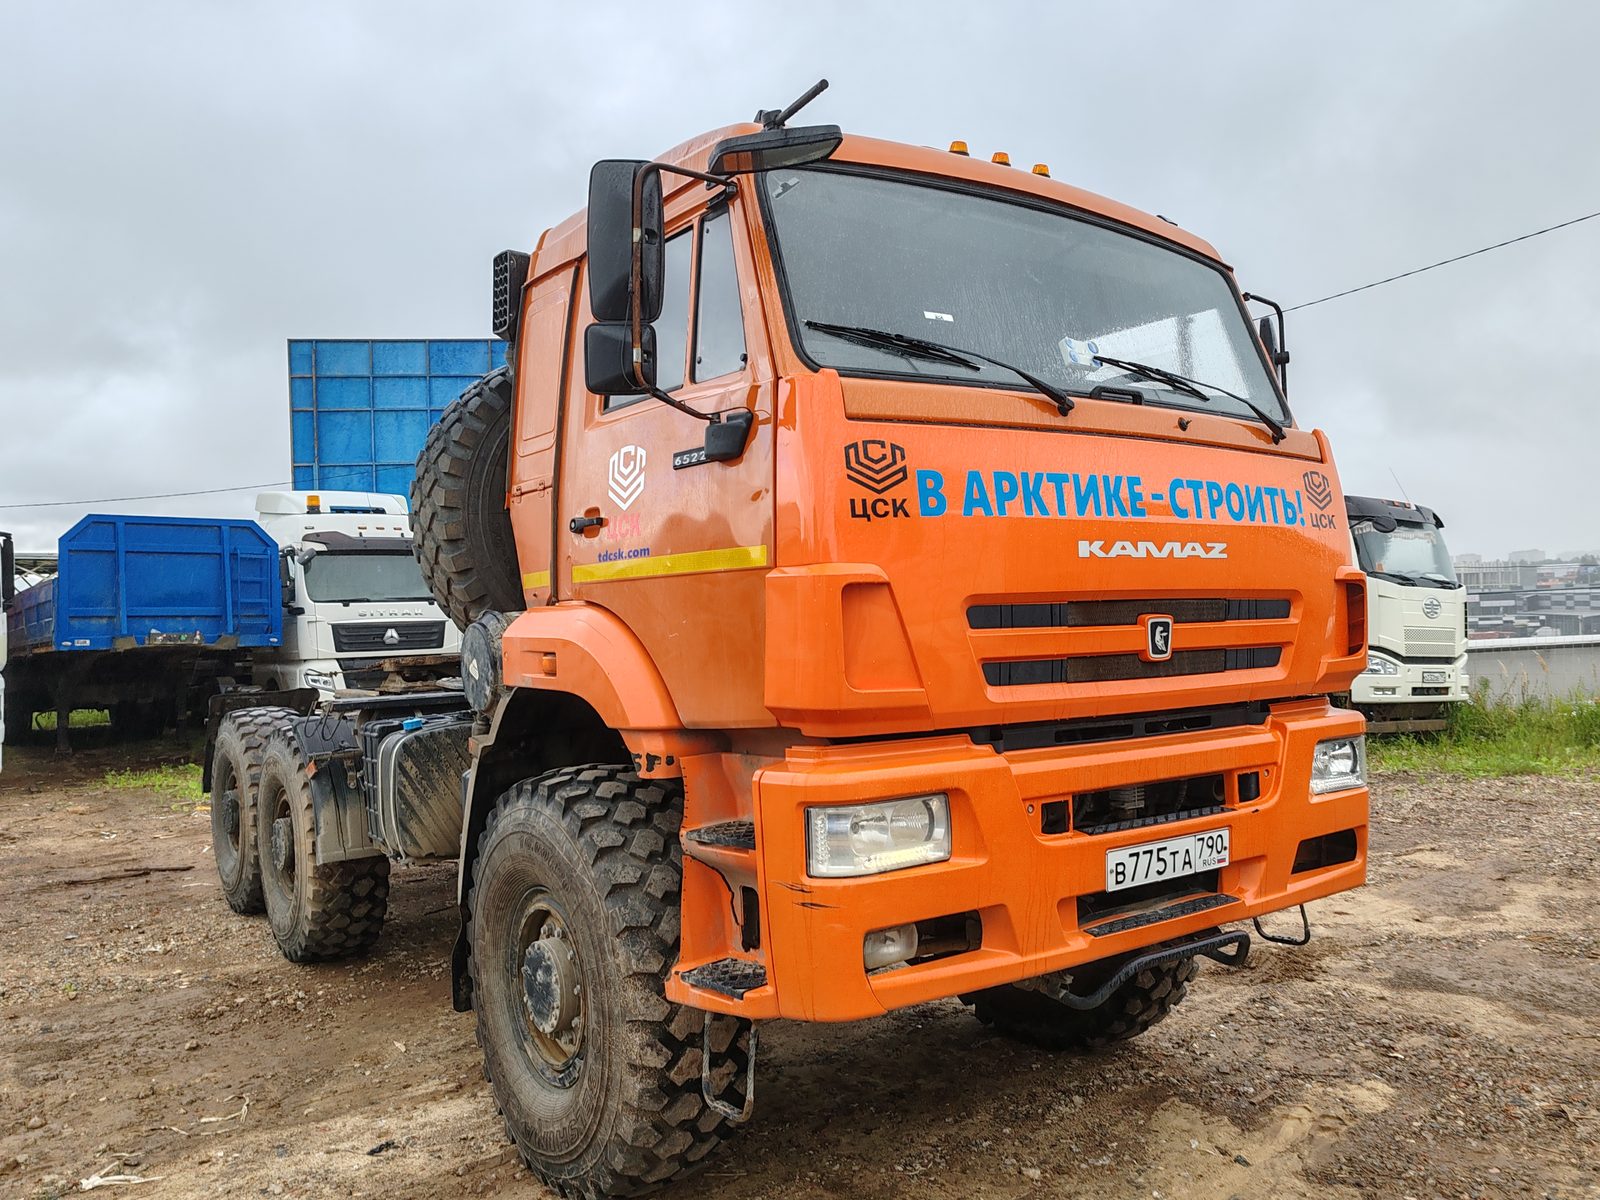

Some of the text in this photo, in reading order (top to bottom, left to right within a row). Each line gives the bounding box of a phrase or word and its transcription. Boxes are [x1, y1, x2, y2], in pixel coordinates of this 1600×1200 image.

[915, 469, 948, 517] В
[849, 498, 910, 522] ЦСК
[606, 511, 641, 543] ЦСК
[1309, 512, 1337, 531] ЦСК
[598, 547, 650, 563] tdcsk.com
[1078, 540, 1229, 559] KAMAZ
[358, 608, 424, 617] SITRAK
[1202, 856, 1217, 867] RUS
